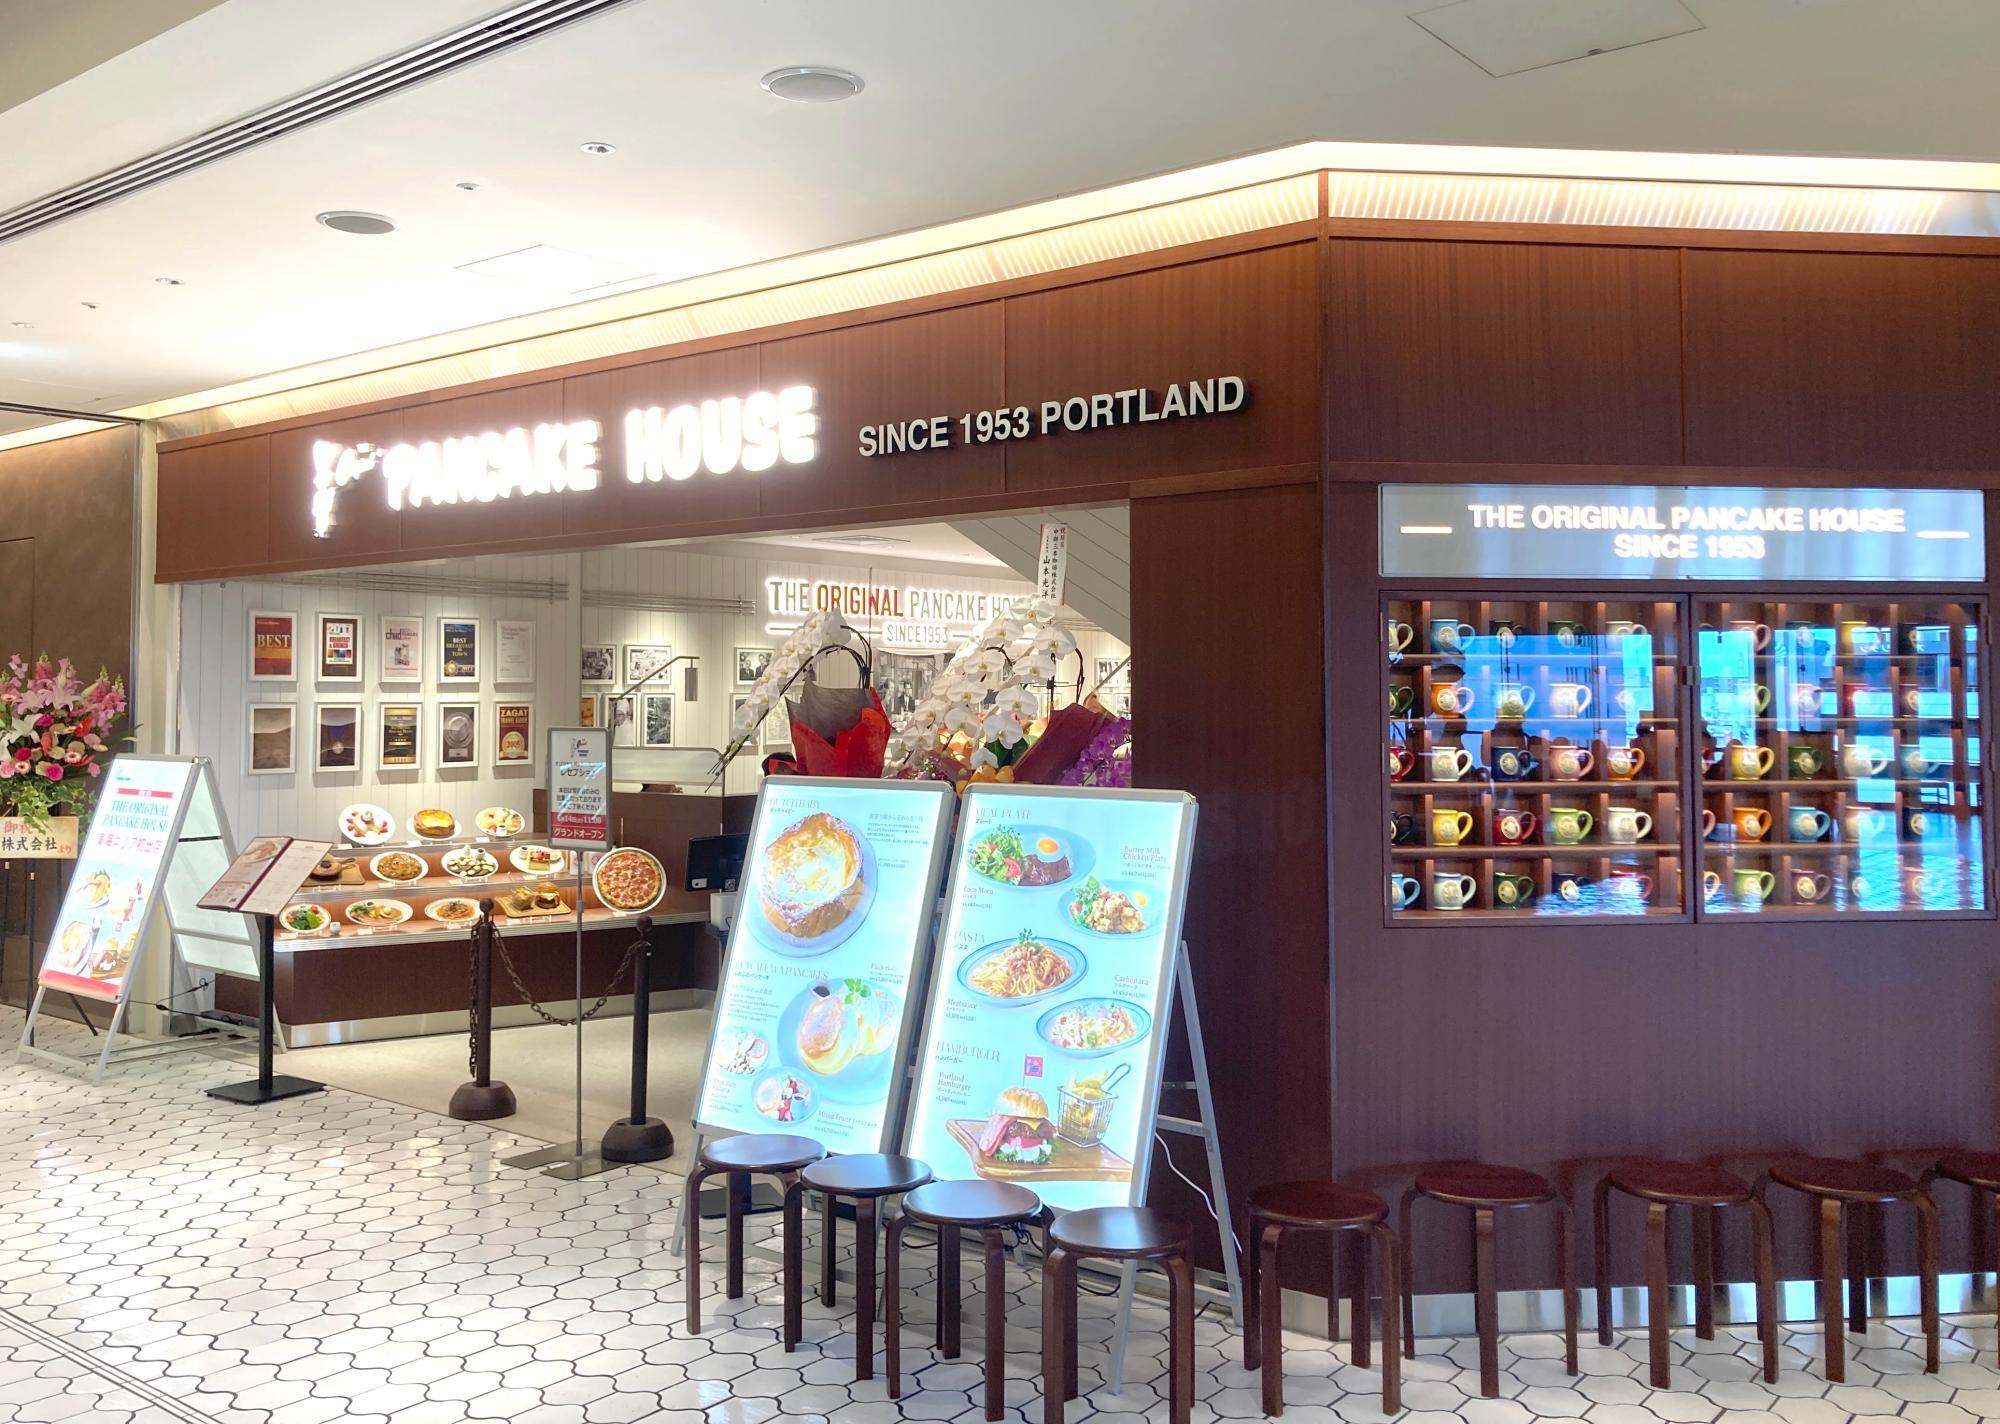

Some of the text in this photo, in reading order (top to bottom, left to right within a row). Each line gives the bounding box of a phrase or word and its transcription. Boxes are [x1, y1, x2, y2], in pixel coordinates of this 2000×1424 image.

[858, 375, 1244, 457] SINCE 1953 PORTLAND
[382, 420, 600, 511] PANCAKE
[625, 385, 817, 484] HOUSE
[1468, 504, 1905, 532] THE ORIGINAL PANCAKE HOUSE
[1614, 534, 1765, 559] SINCE 1953
[769, 581, 809, 611] THE
[816, 584, 903, 617] ORIGINAL
[910, 590, 985, 621] PANCAKE
[257, 634, 290, 647] BEST
[887, 624, 948, 643] SINCE 1953
[500, 709, 528, 717] ZAGAT
[111, 800, 169, 817] THE ORIGINAL
[999, 808, 1031, 820] PLATE
[102, 813, 168, 832] PANCAKE HOUSE
[554, 828, 605, 839] グランドオープン
[2, 836, 58, 851] 株式会社
[954, 931, 985, 945] PASTA
[1114, 974, 1149, 986] Carbonara
[936, 1041, 1000, 1063] HAMBURGER
[938, 1079, 971, 1090] Hamburger
[939, 1072, 965, 1082] Portland
